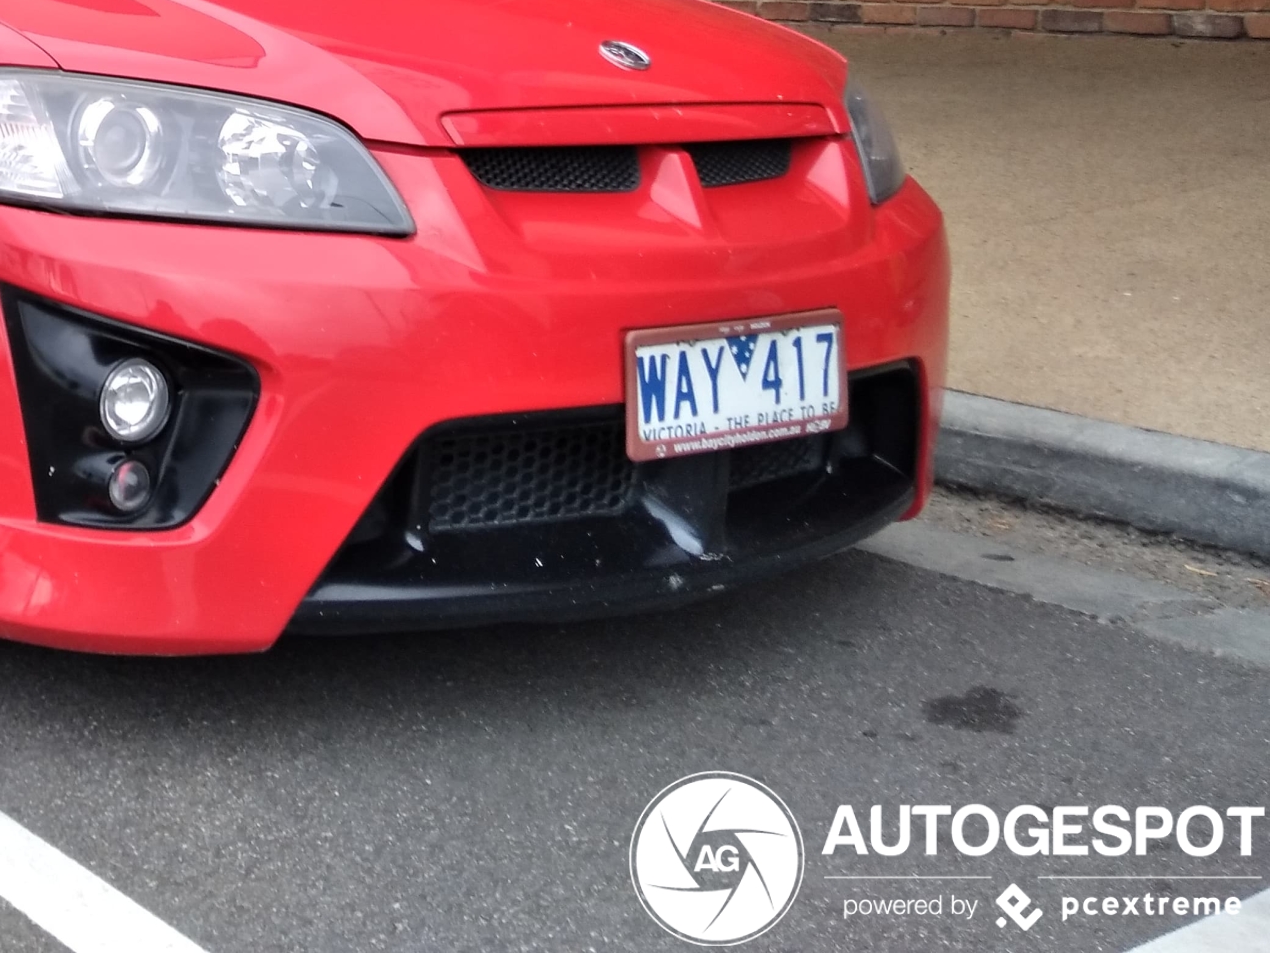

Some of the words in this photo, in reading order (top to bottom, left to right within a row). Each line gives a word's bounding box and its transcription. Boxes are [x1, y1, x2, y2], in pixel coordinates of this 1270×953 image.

[637, 346, 725, 424] WAY
[762, 332, 834, 404] 417
[643, 424, 707, 441] VICTORIA
[727, 415, 750, 429] THE
[757, 408, 794, 426] PLACE
[800, 405, 815, 419] TO
